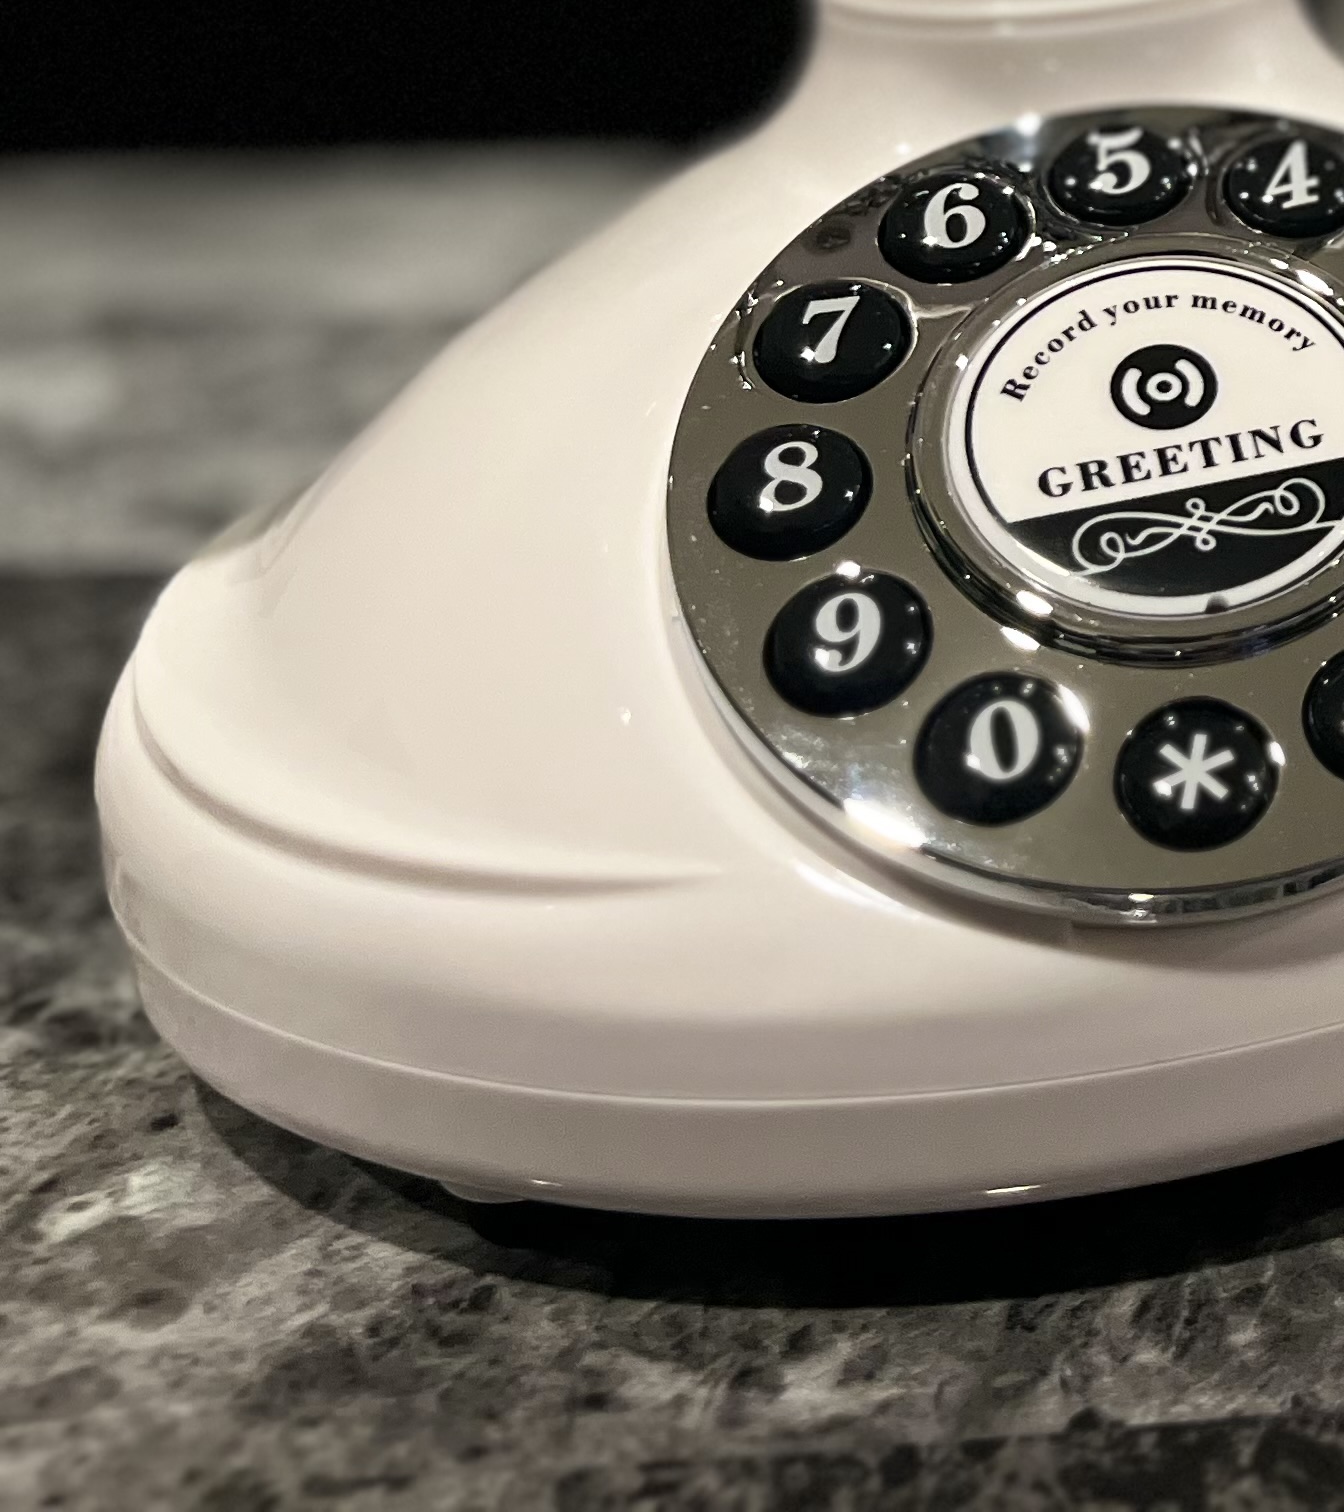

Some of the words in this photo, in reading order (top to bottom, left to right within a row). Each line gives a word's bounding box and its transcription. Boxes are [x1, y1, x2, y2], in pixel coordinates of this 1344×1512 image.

[1087, 128, 1151, 196] 5
[1260, 141, 1320, 210] 4
[920, 181, 987, 250] 6
[799, 294, 861, 365] 7
[998, 310, 1097, 403] Record
[1102, 292, 1180, 326] your
[1190, 292, 1318, 353] memory
[757, 440, 824, 515] 8
[1036, 417, 1326, 501] GREETING
[813, 591, 882, 674] 9
[966, 699, 1036, 782] 0
